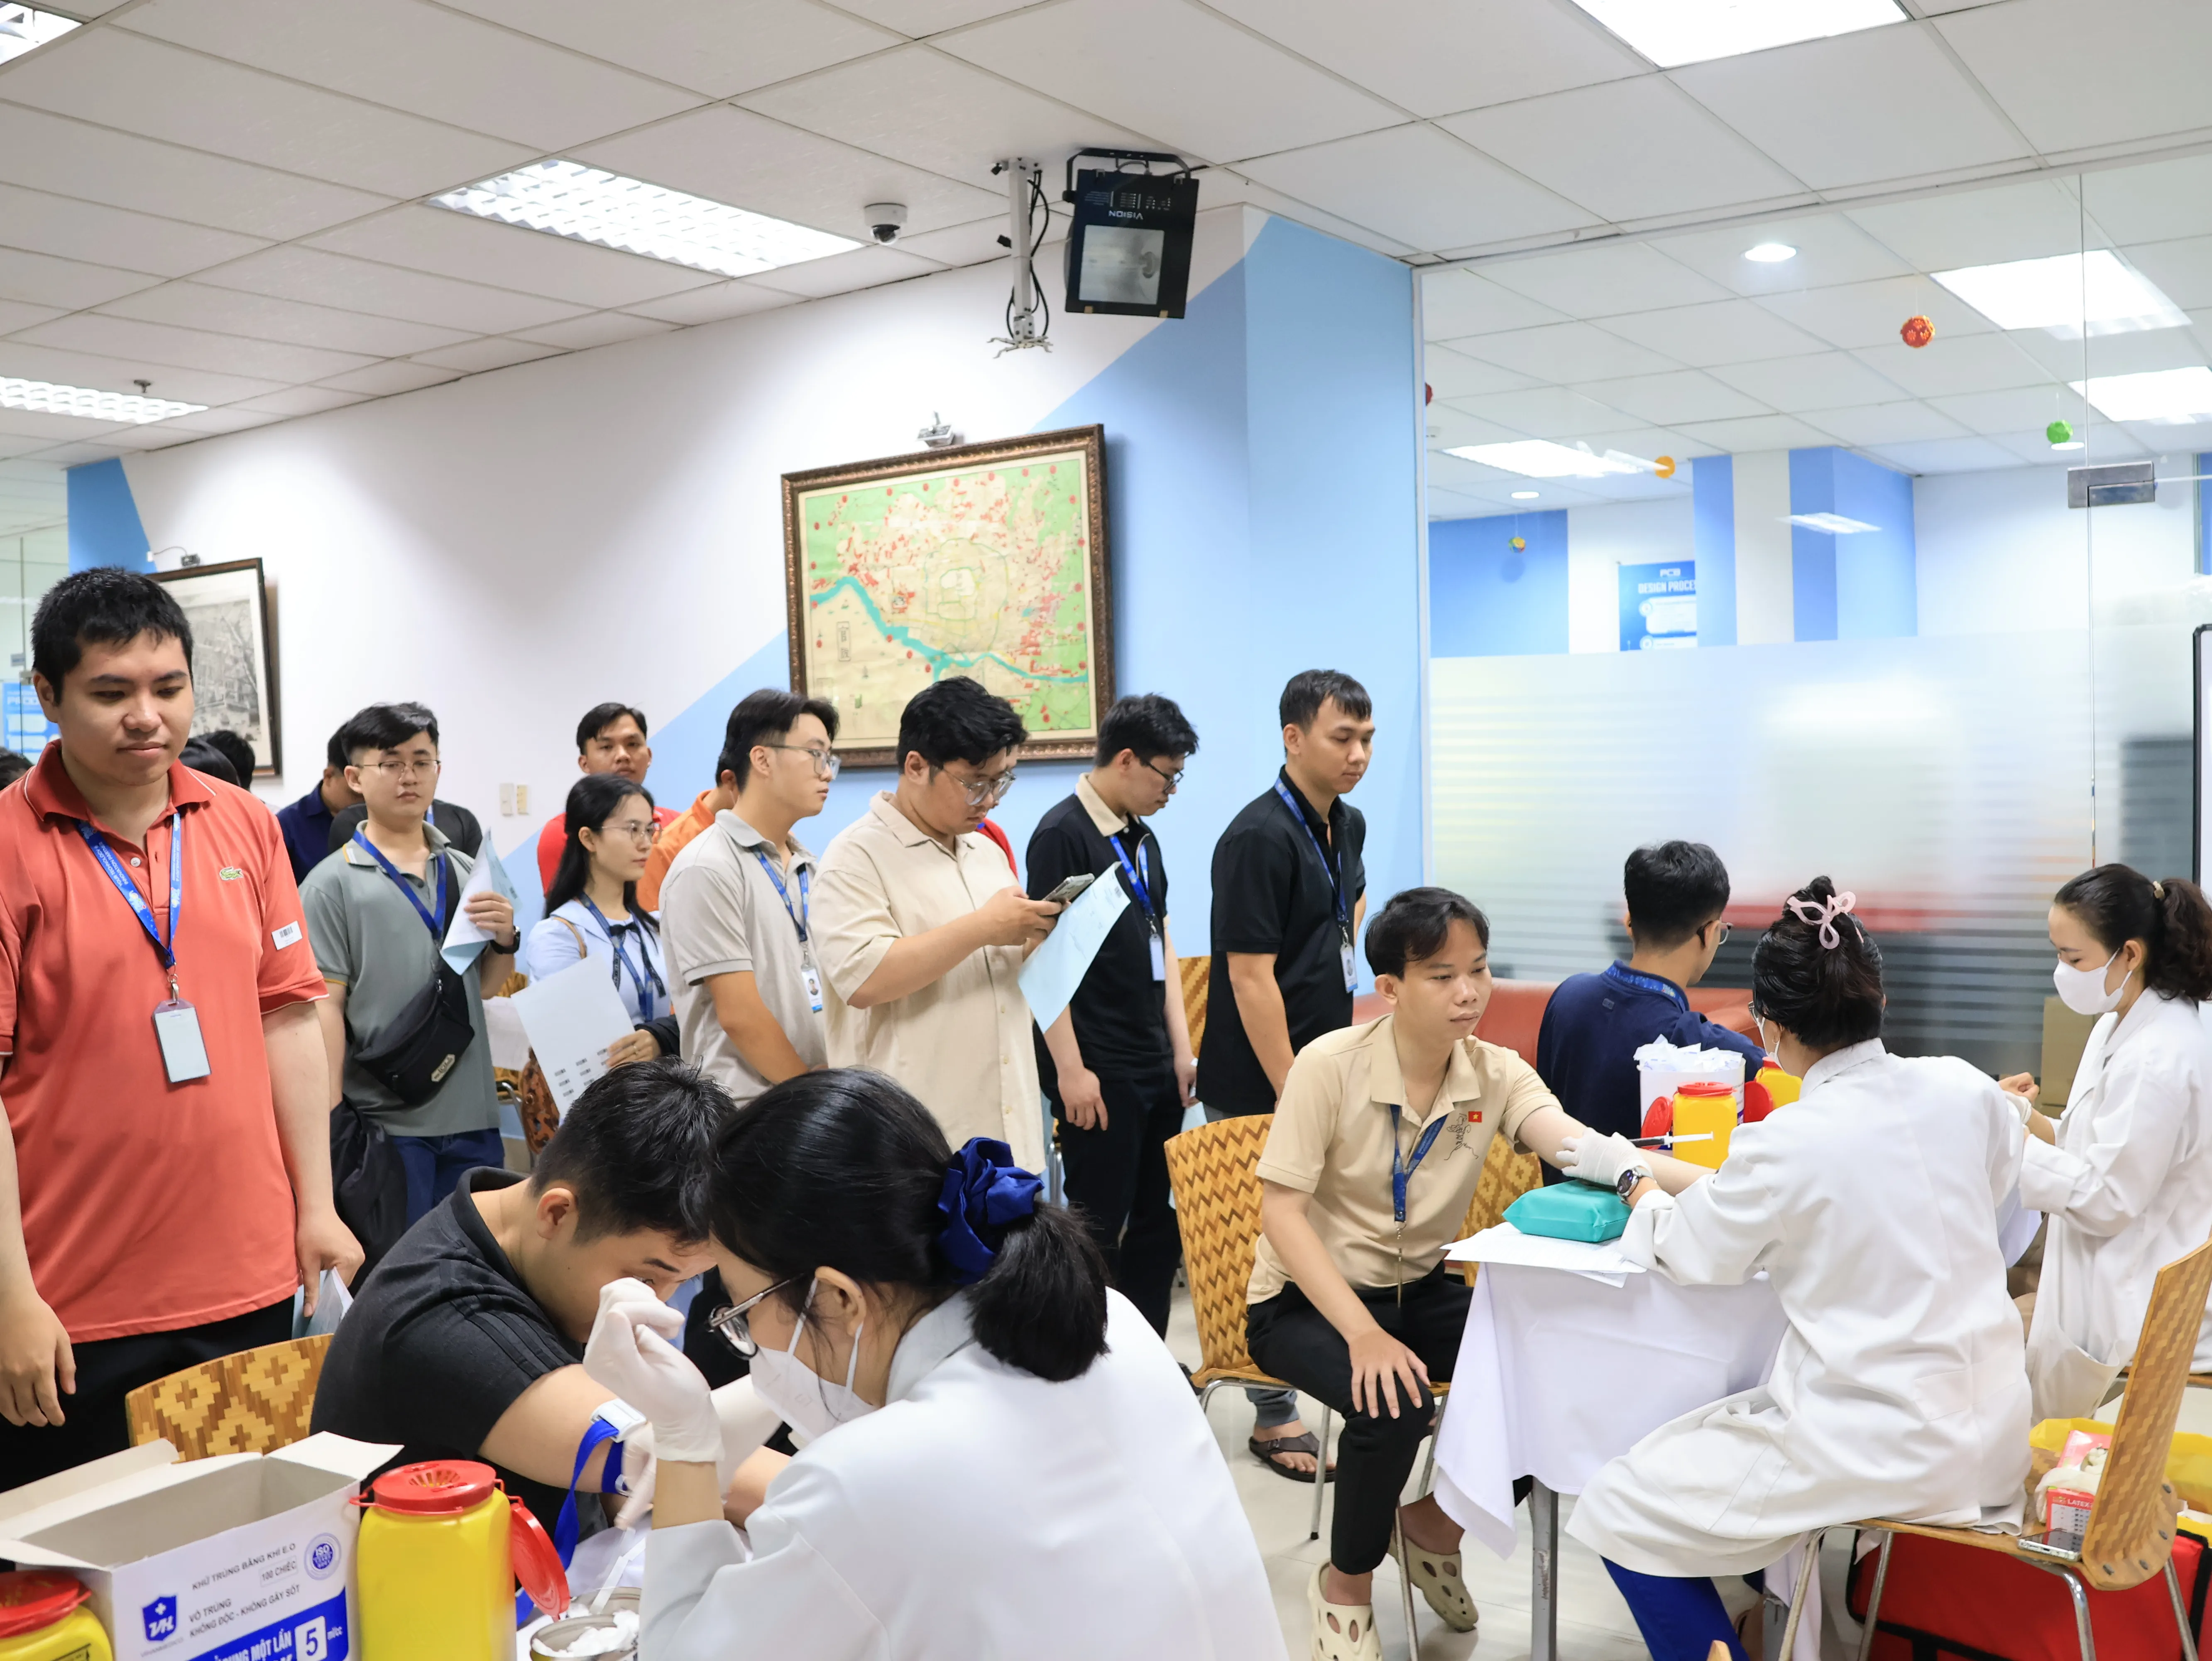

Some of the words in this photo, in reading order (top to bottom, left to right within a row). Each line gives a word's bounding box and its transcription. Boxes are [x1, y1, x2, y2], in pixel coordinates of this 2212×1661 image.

[1108, 210, 1143, 220] VISION
[1638, 581, 1667, 594] DESIGN
[306, 1627, 318, 1656] 5
